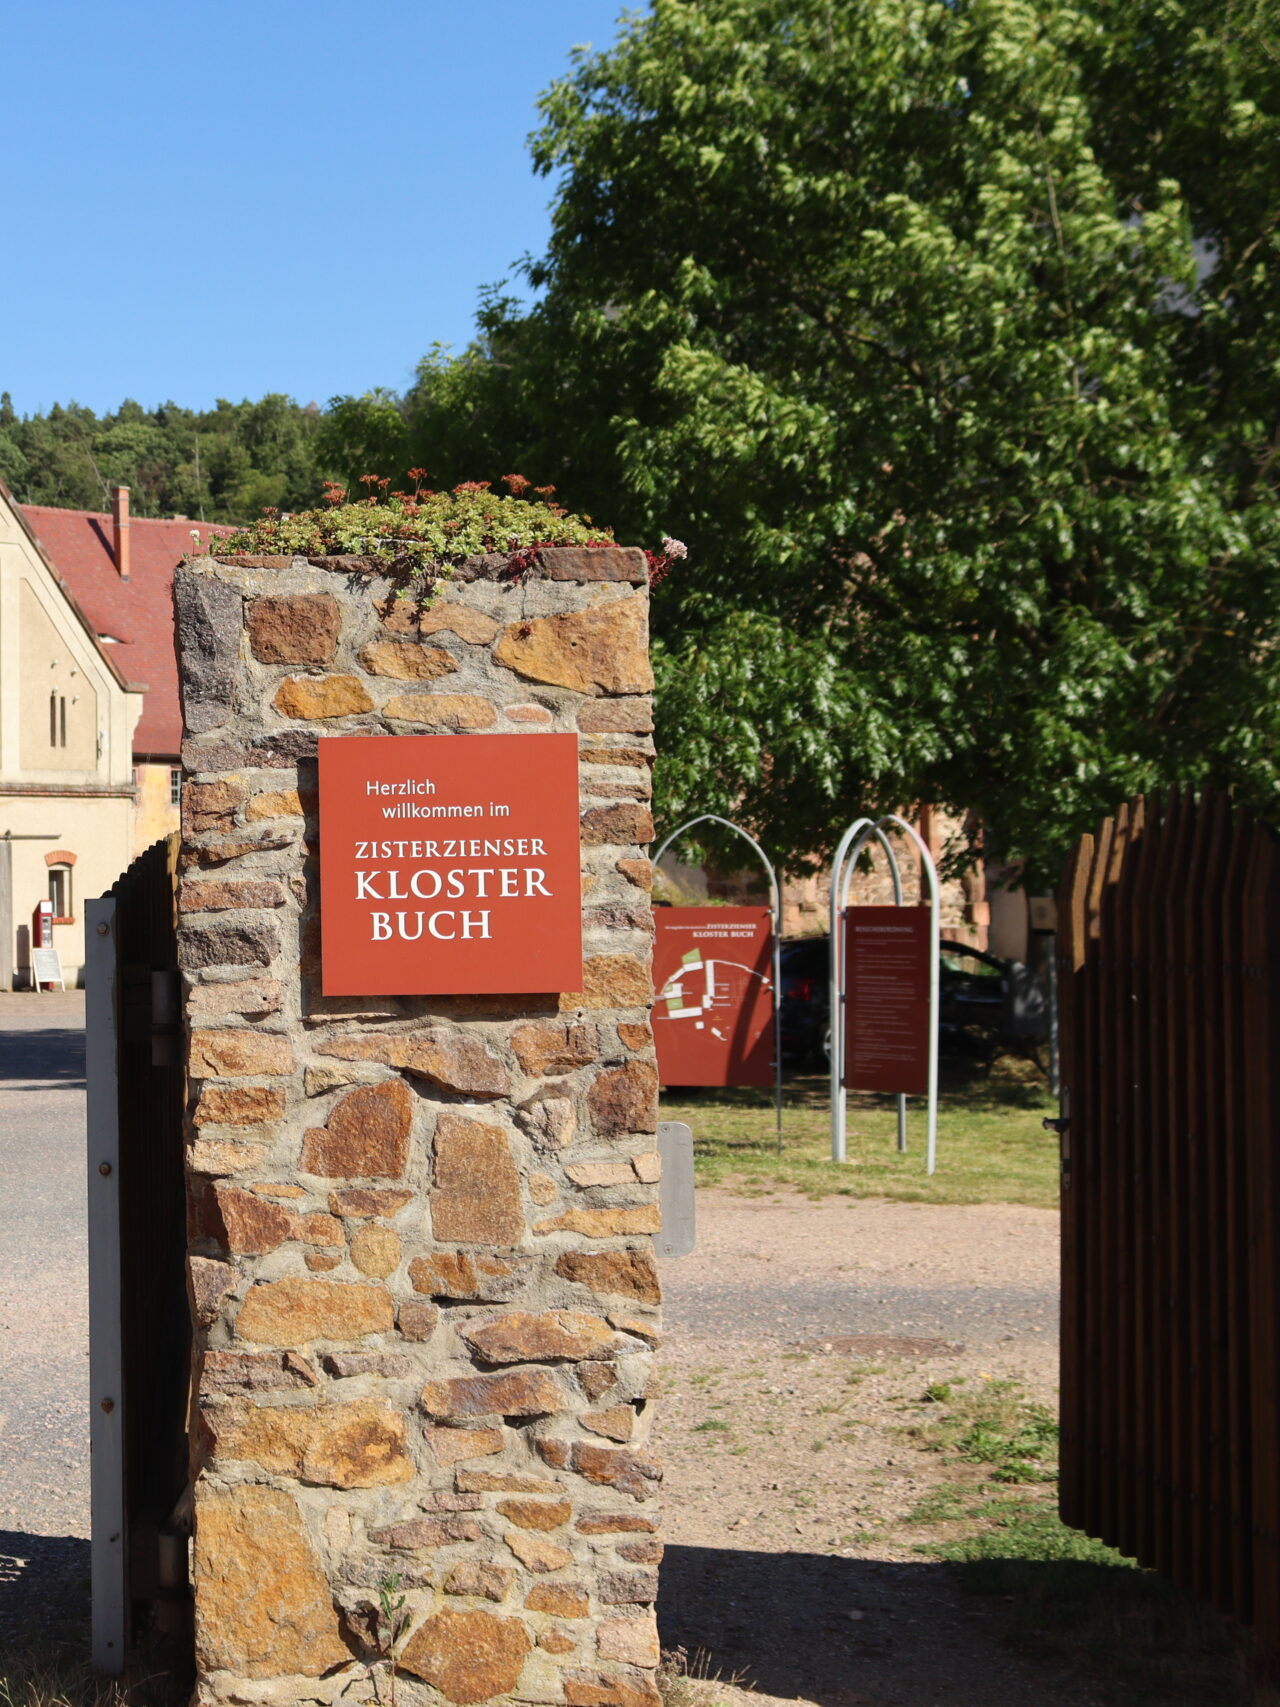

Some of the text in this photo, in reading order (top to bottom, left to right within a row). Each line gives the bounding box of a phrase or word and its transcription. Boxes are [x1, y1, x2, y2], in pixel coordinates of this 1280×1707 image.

[366, 779, 436, 796] Herzlich
[382, 802, 510, 819] willkommen im
[354, 838, 548, 859] ZISTERZIENSER
[354, 867, 553, 900] KLOSTER
[370, 909, 493, 941] BUCH
